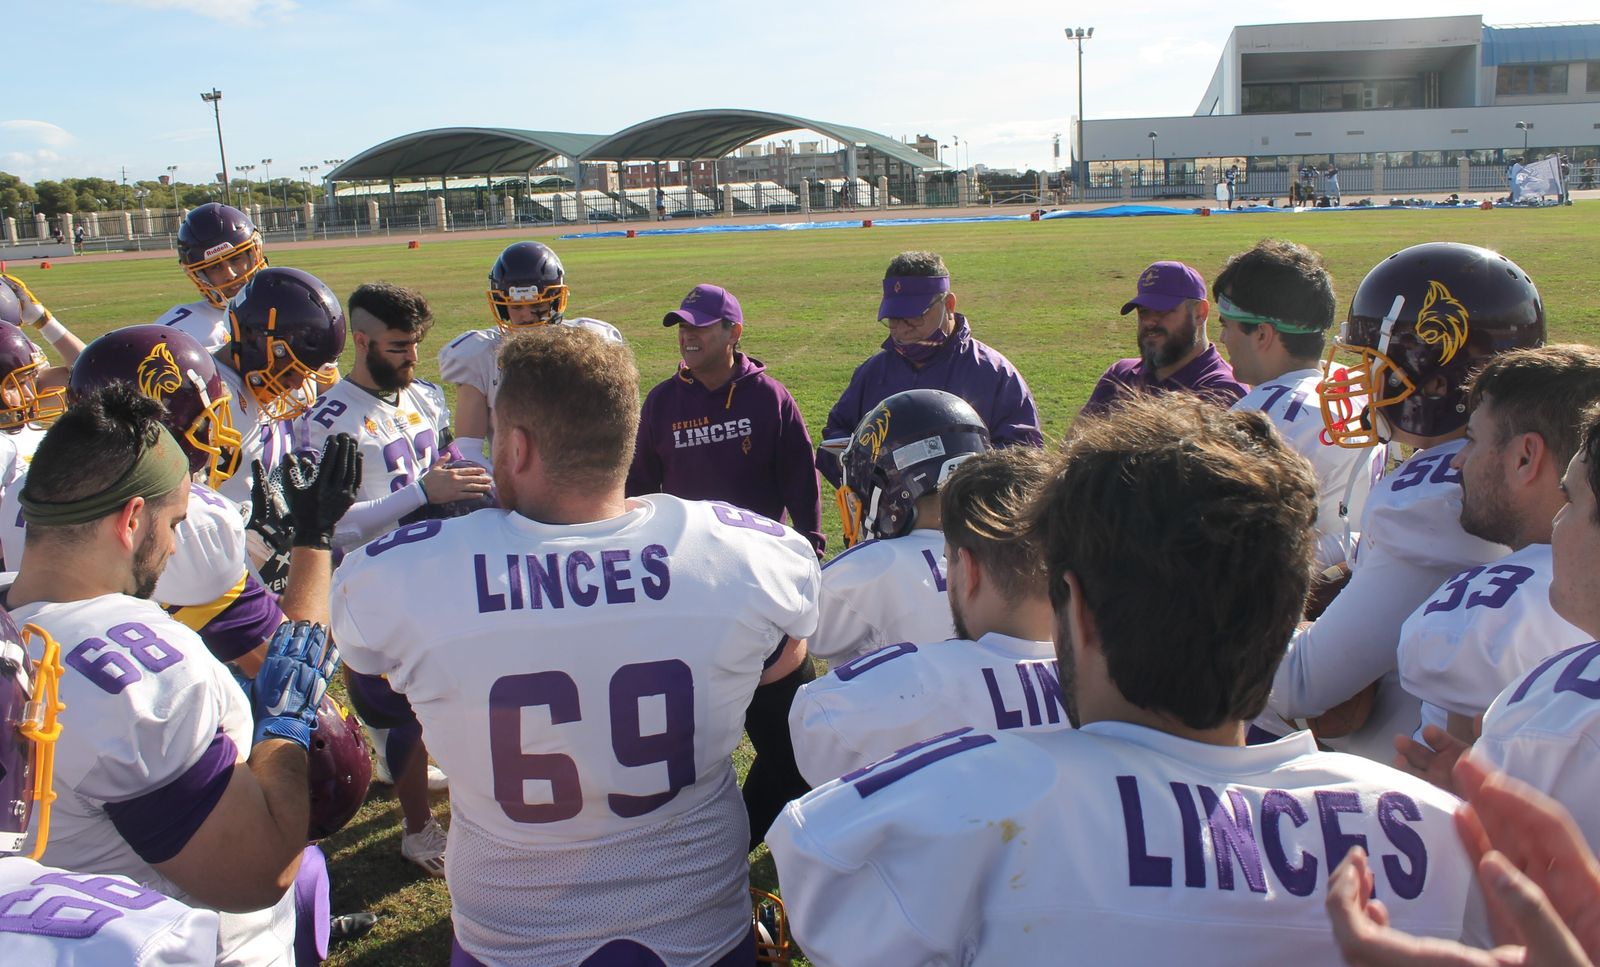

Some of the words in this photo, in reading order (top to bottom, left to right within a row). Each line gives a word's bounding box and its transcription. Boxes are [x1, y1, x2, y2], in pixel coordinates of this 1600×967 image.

[206, 243, 229, 256] Riddell
[672, 416, 710, 431] SEVILLA
[673, 418, 752, 449] LINCES
[474, 543, 671, 614] LINCES
[1423, 564, 1535, 617] 33
[65, 621, 184, 695] 68
[981, 660, 1063, 730] LIN
[488, 658, 697, 824] 69
[1116, 775, 1429, 901] LINCES
